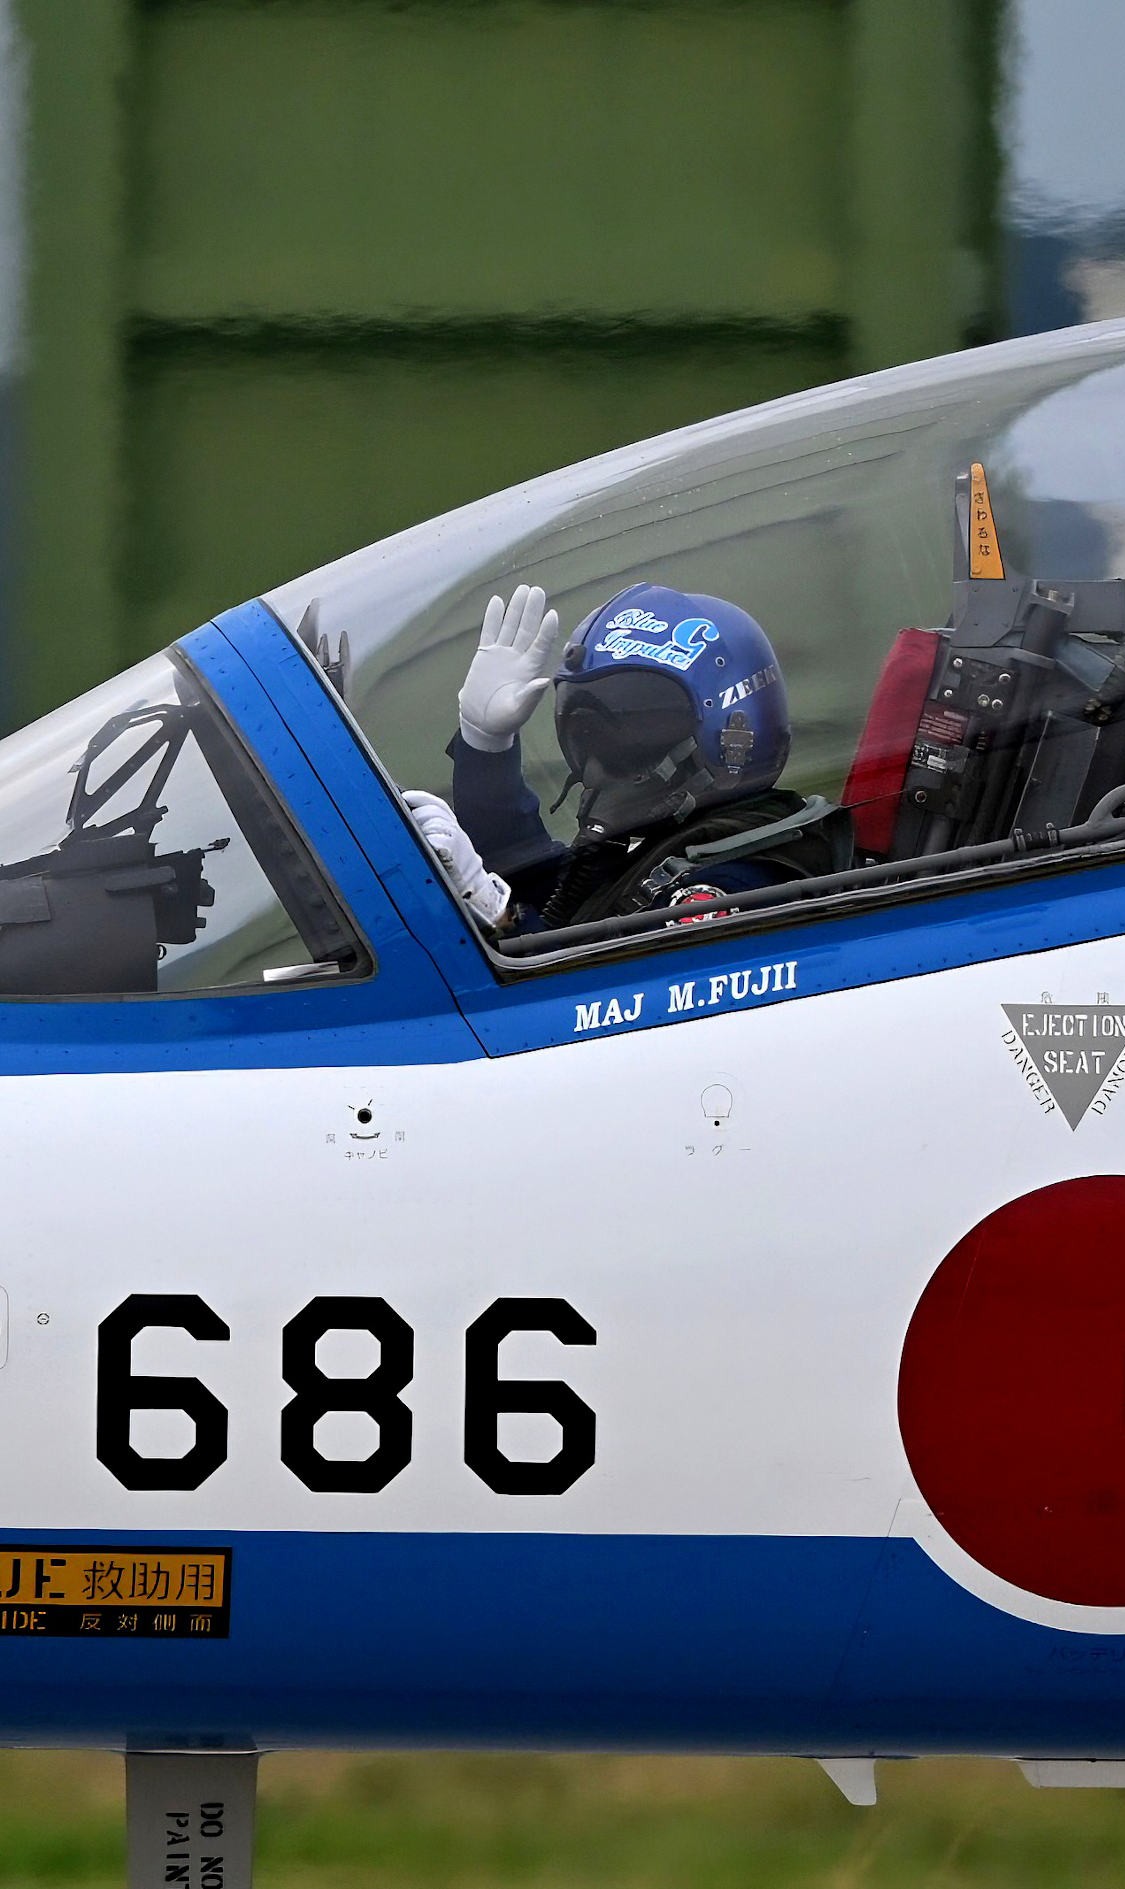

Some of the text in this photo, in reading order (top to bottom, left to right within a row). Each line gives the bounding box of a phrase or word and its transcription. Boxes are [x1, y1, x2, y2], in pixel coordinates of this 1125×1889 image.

[606, 608, 669, 634] Blue
[573, 961, 798, 1033] MAJ M.FUJII
[1001, 1030, 1056, 1114] DANGER
[1043, 1050, 1106, 1074] SEAT
[96, 1292, 597, 1497] 686
[81, 1560, 215, 1601] 救助用
[200, 1802, 224, 1838] DO
[165, 1812, 190, 1889] PAIN
